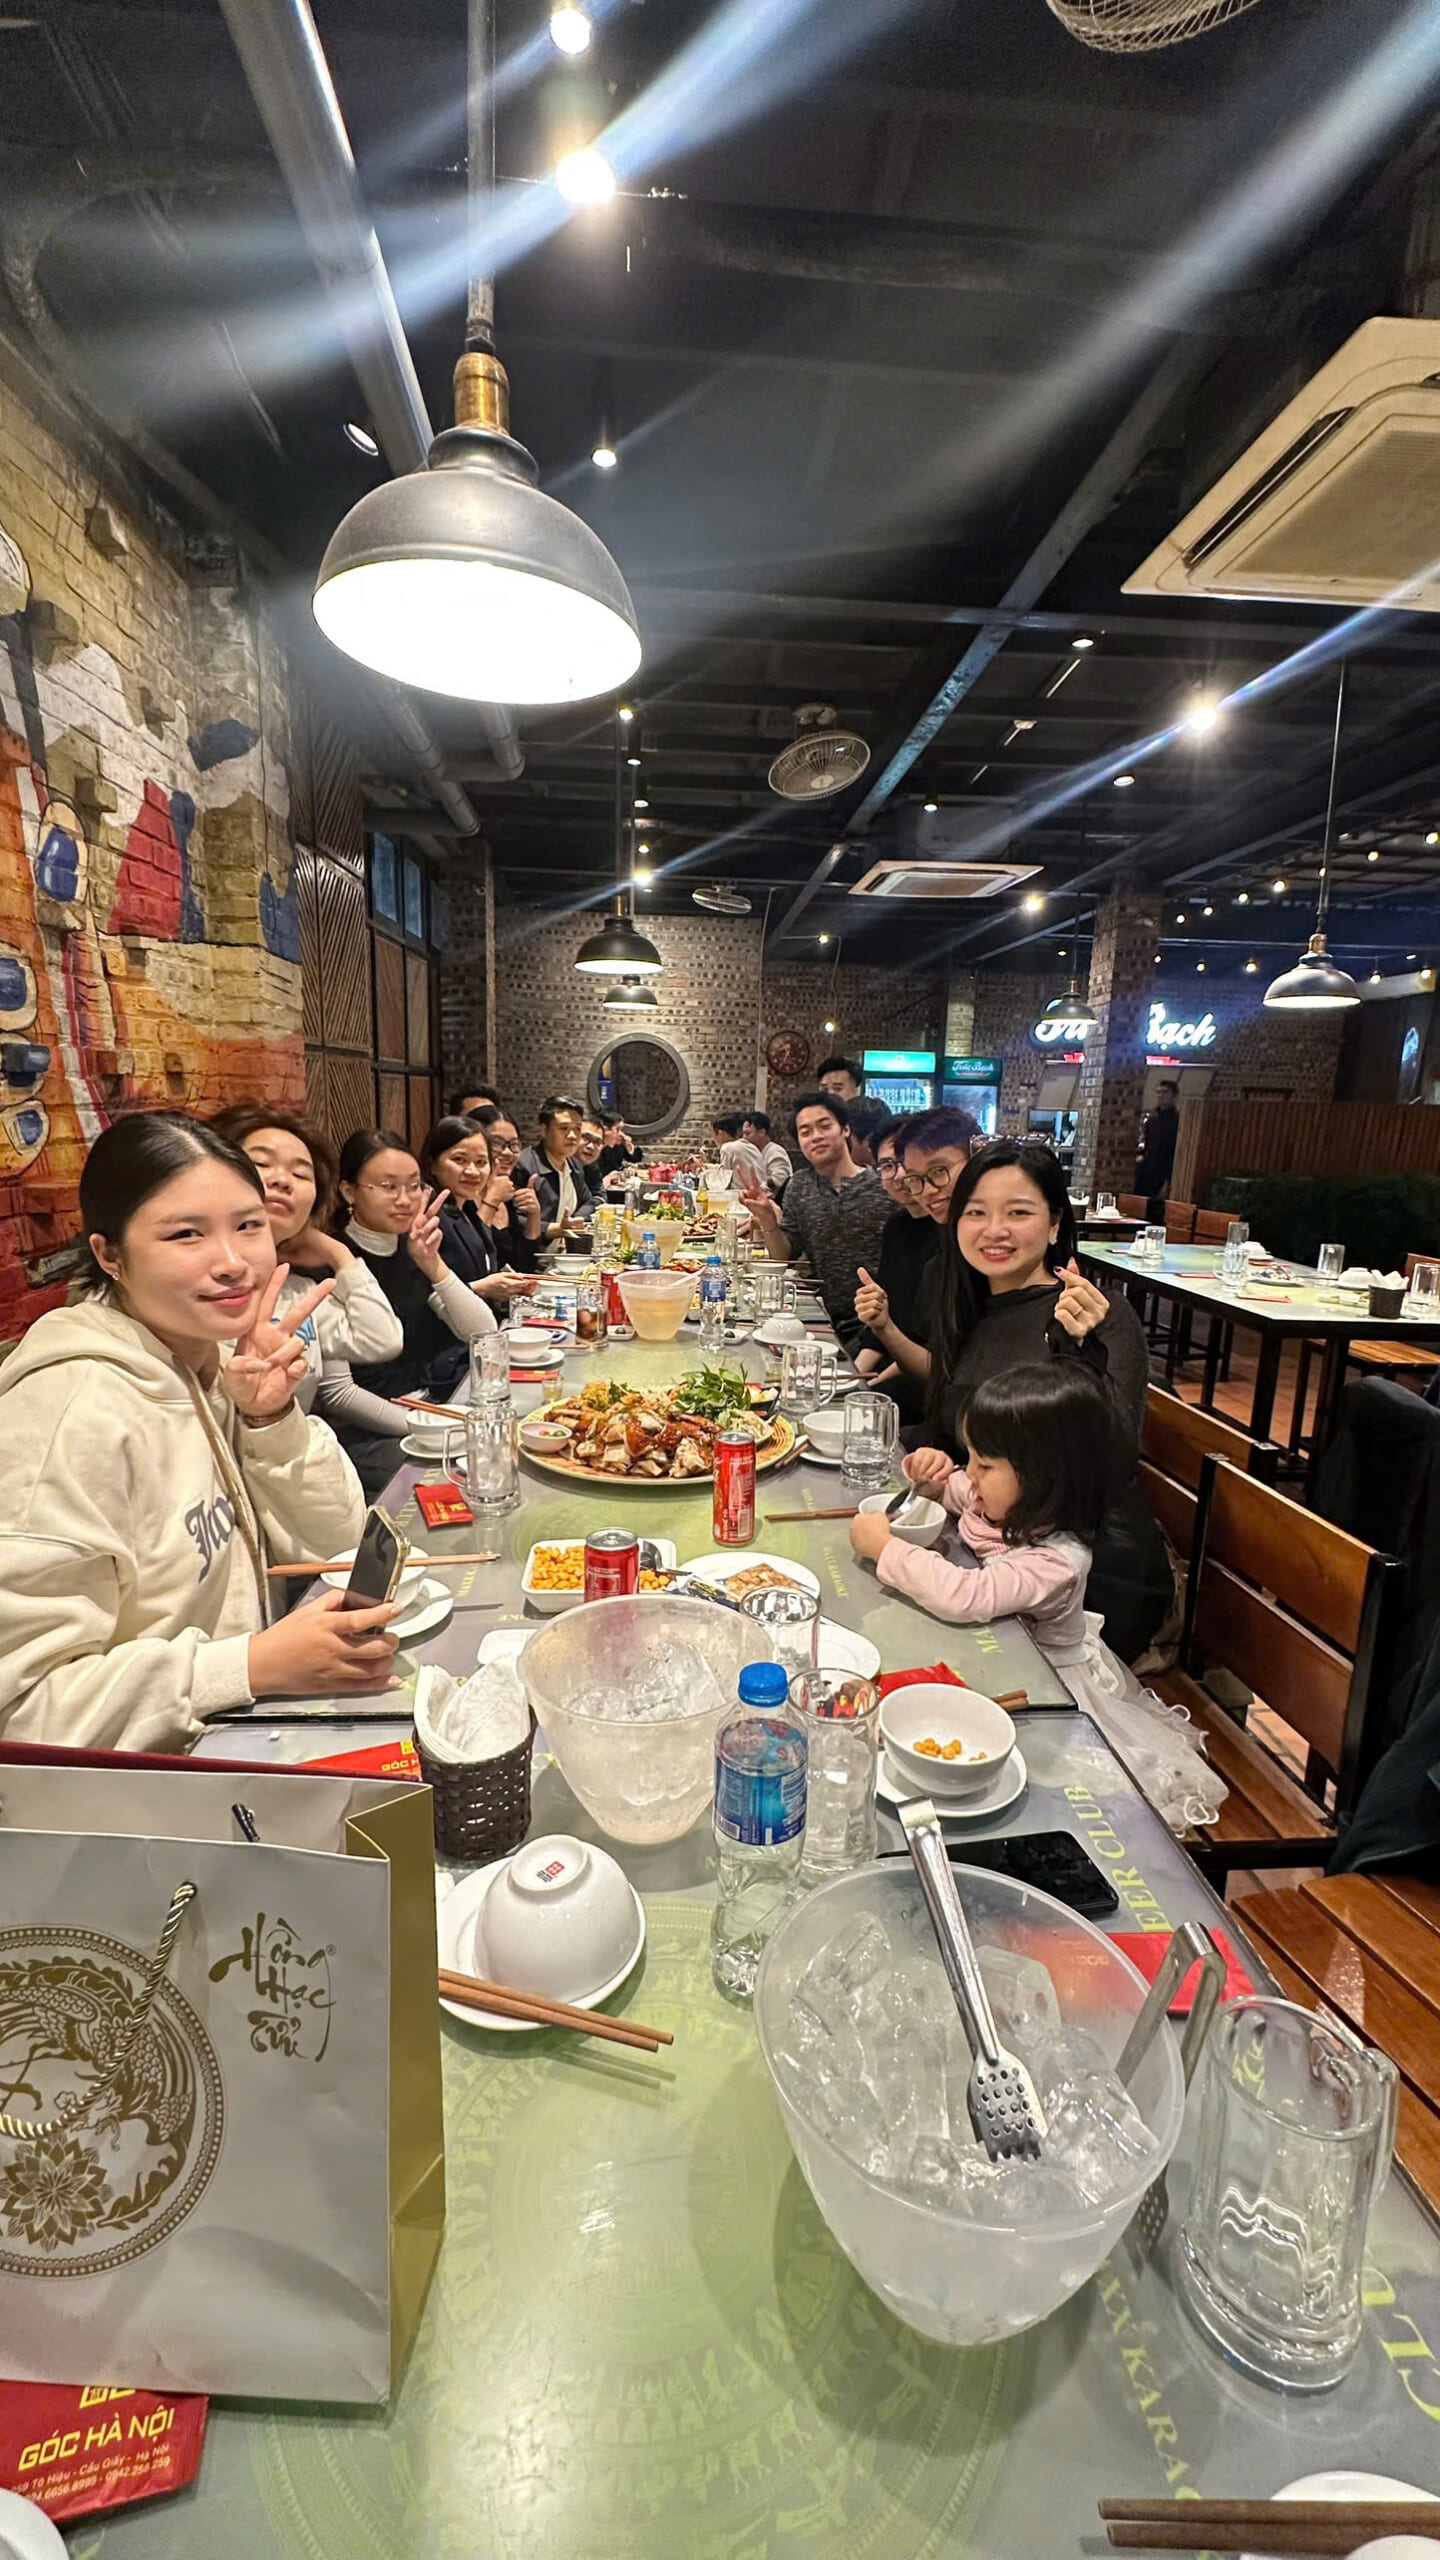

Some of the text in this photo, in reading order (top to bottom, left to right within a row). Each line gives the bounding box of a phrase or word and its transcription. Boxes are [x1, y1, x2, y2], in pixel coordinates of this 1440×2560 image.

[1064, 1786, 1175, 1933] EER CLUB
[18, 2405, 175, 2471] GÓC HÀ NỘI
[1121, 2347, 1201, 2500] KARA
